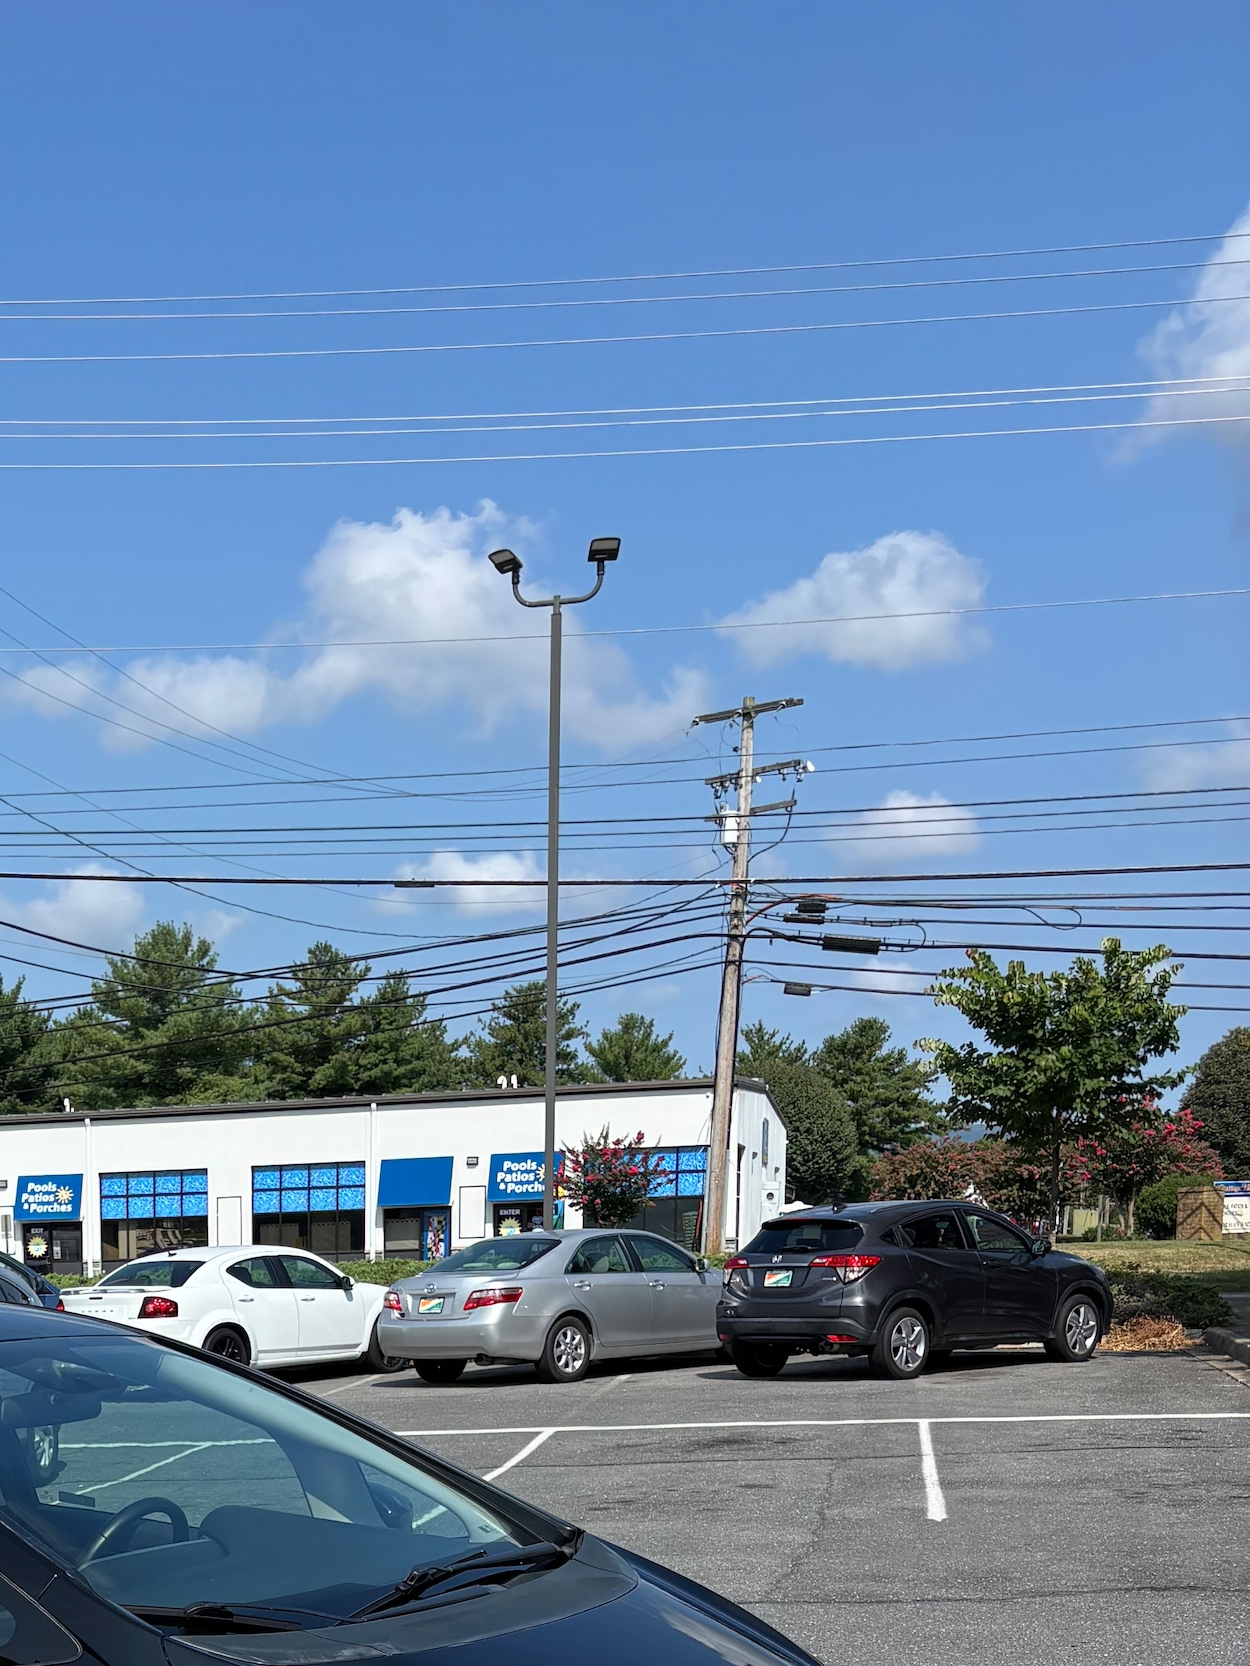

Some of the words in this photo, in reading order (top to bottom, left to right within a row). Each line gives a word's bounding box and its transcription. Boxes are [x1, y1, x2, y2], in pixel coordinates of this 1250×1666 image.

[503, 1159, 537, 1171] Pools
[496, 1171, 535, 1182] Patios
[27, 1182, 57, 1192] Pools
[506, 1181, 546, 1193] Porch
[21, 1193, 56, 1203] Patios
[30, 1203, 72, 1213] Porches
